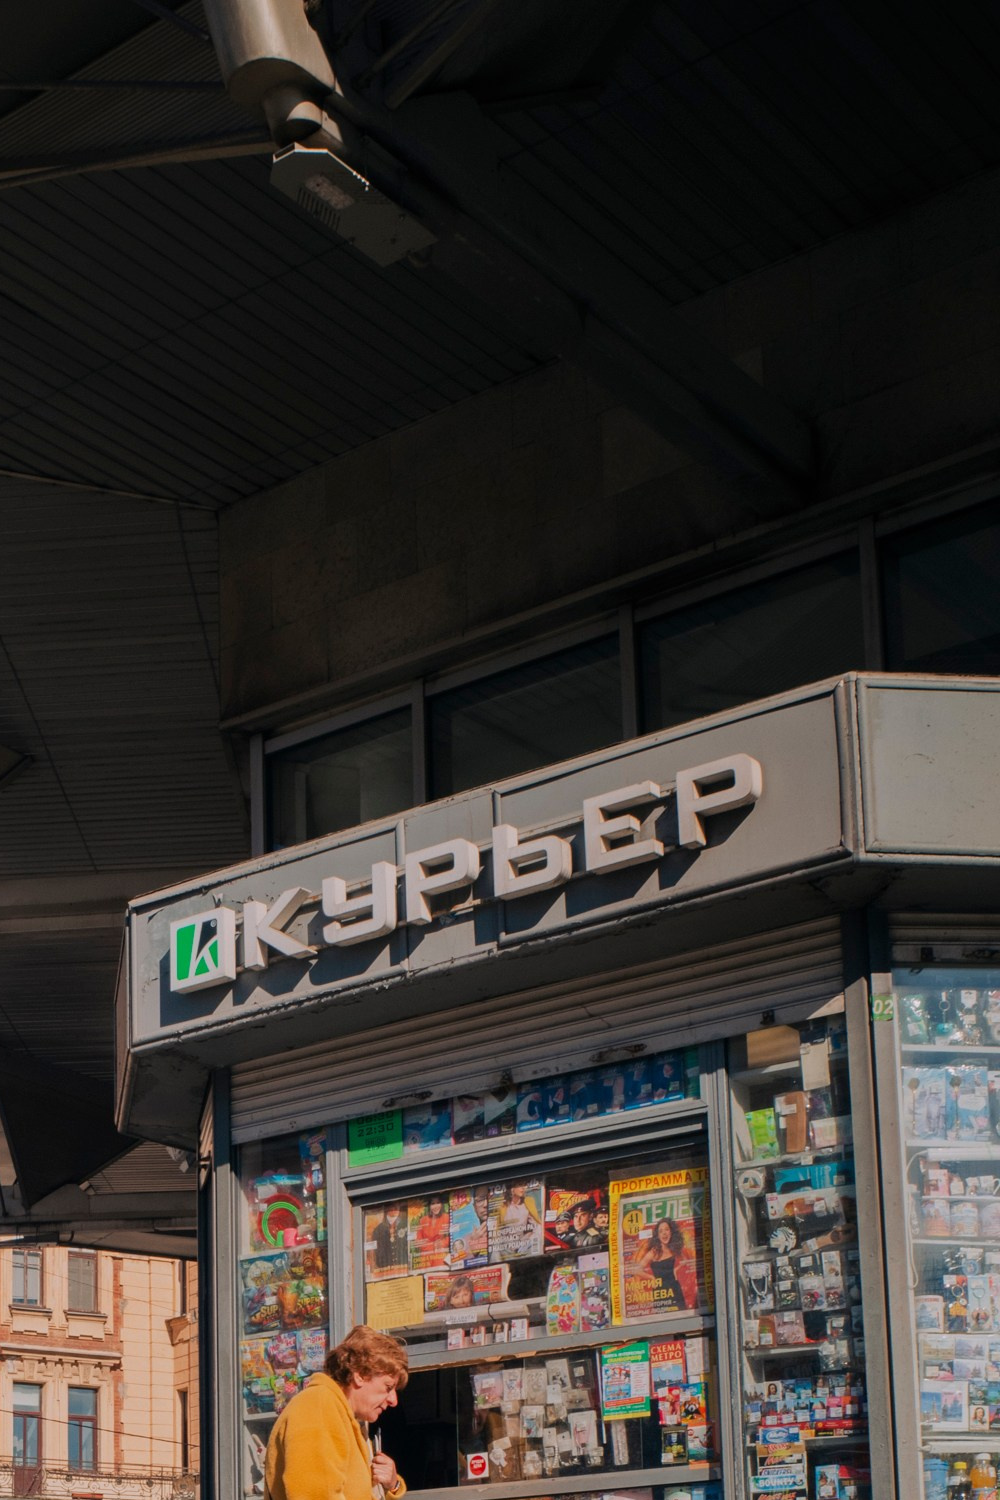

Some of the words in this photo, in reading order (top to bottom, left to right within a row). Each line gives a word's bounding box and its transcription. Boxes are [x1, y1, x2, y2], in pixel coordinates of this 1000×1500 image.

[241, 752, 763, 972] КУРЬЕР
[873, 998, 894, 1015] 02
[357, 1122, 394, 1138] 22:30
[611, 1171, 693, 1194] ПРОГРАММА
[637, 1196, 703, 1225] ТЕЛЕК
[610, 1232, 618, 1257] ТЕЛЕК
[625, 1277, 663, 1294] МАРИЯ
[625, 1287, 675, 1305] ЗАЙЦЕВА
[640, 1300, 672, 1309] АУДИТОРИЯ
[650, 1343, 682, 1355] СХЕМА
[650, 1350, 682, 1362] МЕТРО
[758, 1477, 794, 1487] BOUNTY
